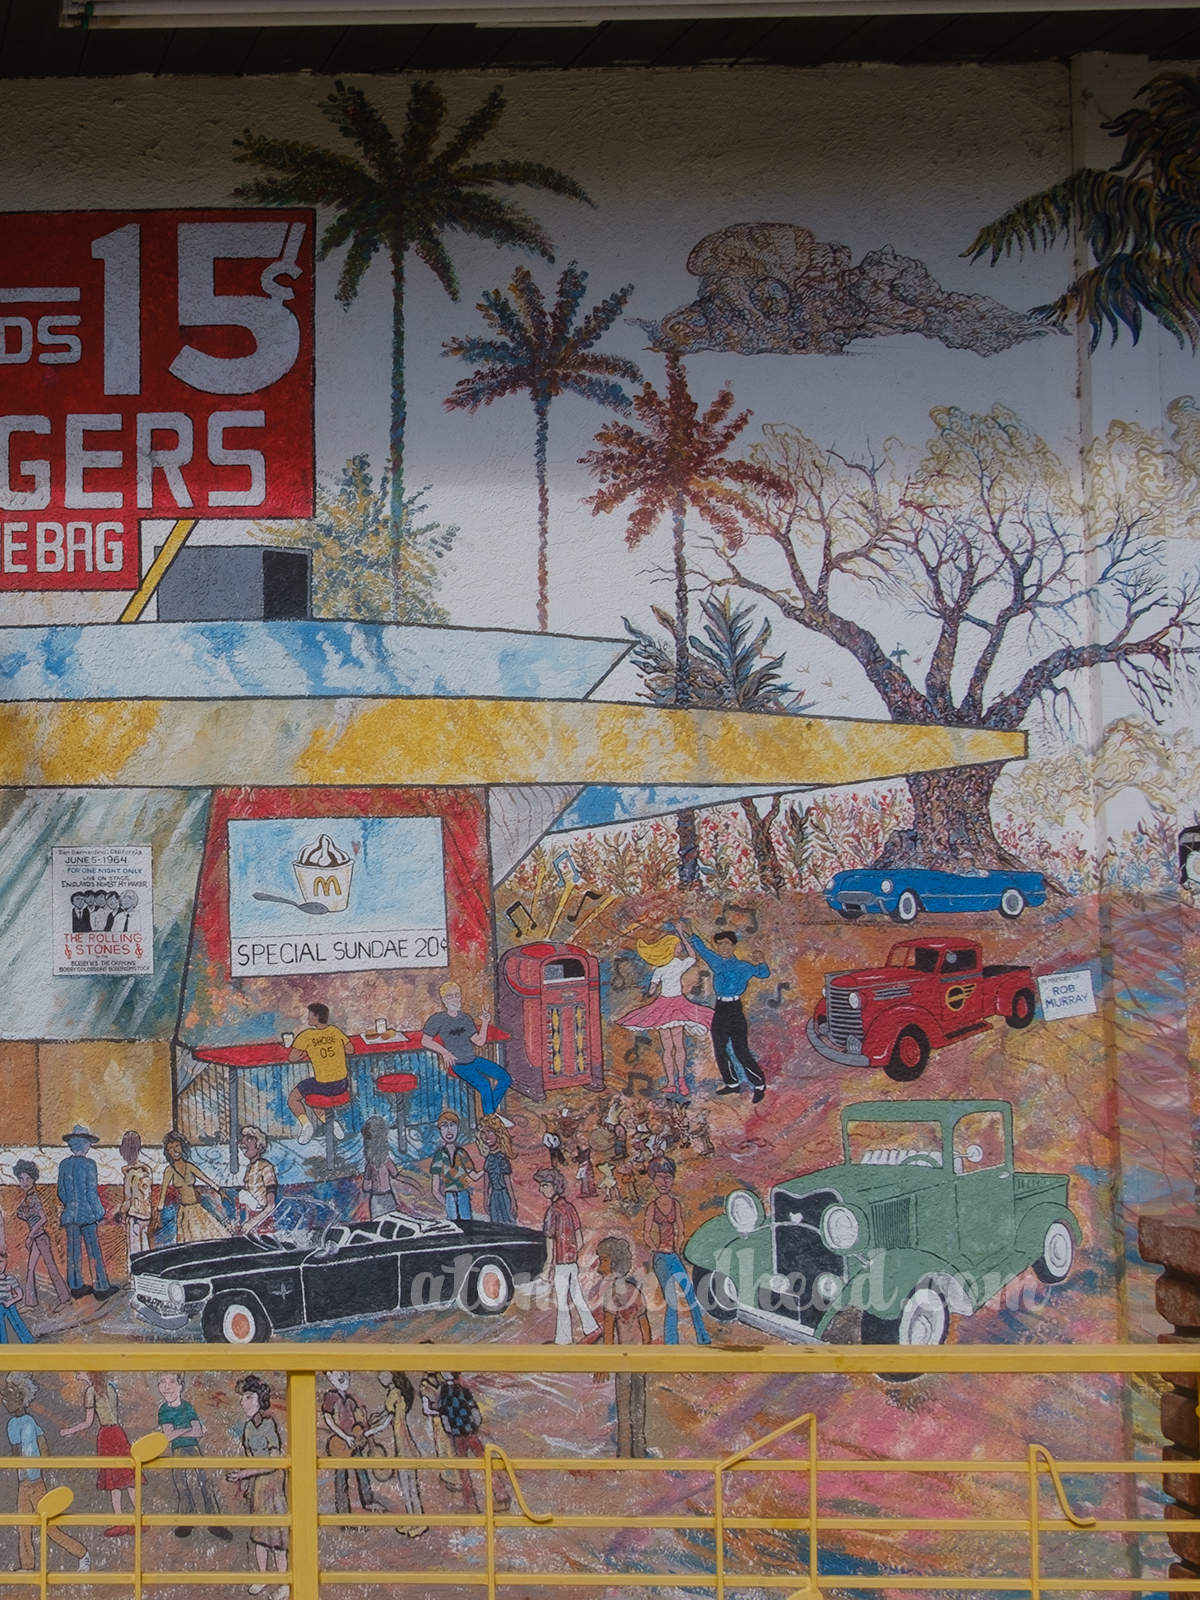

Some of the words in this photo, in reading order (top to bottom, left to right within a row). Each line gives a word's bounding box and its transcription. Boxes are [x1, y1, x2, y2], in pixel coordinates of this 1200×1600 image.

[36, 521, 126, 573] BAG
[64, 856, 90, 864] JUNE
[64, 933, 84, 943] THE
[88, 933, 143, 943] ROLLING
[75, 944, 131, 955] STONES
[237, 942, 327, 966] SPECIAL
[333, 939, 408, 961] SUNDAE
[414, 936, 448, 958] 20¢
[1052, 984, 1076, 996] ROB
[1045, 993, 1089, 1008] MURRAY
[319, 1046, 336, 1059] 05
